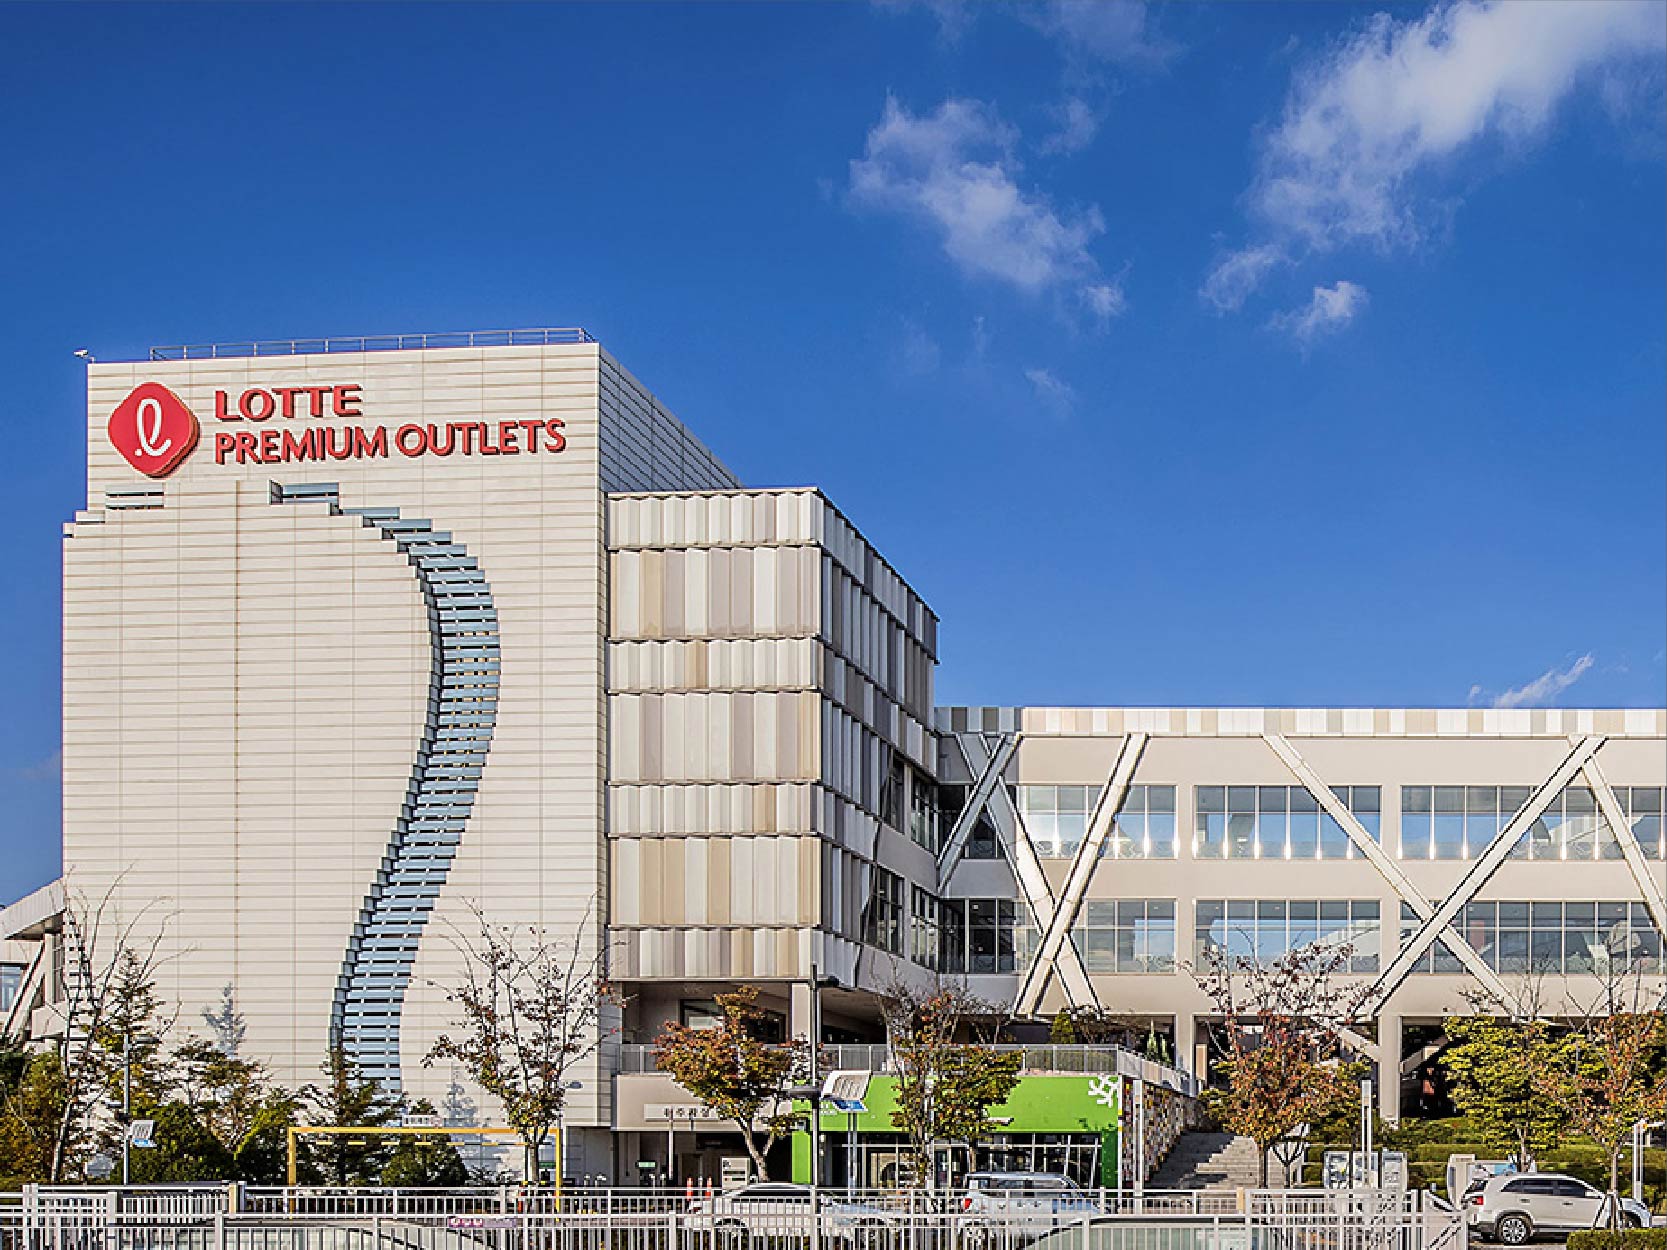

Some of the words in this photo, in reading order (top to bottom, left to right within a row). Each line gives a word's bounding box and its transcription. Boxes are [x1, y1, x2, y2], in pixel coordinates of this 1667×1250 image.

[214, 384, 363, 422] LOTTE
[214, 425, 389, 465] PREMIUM
[394, 417, 567, 457] OUTLETS
